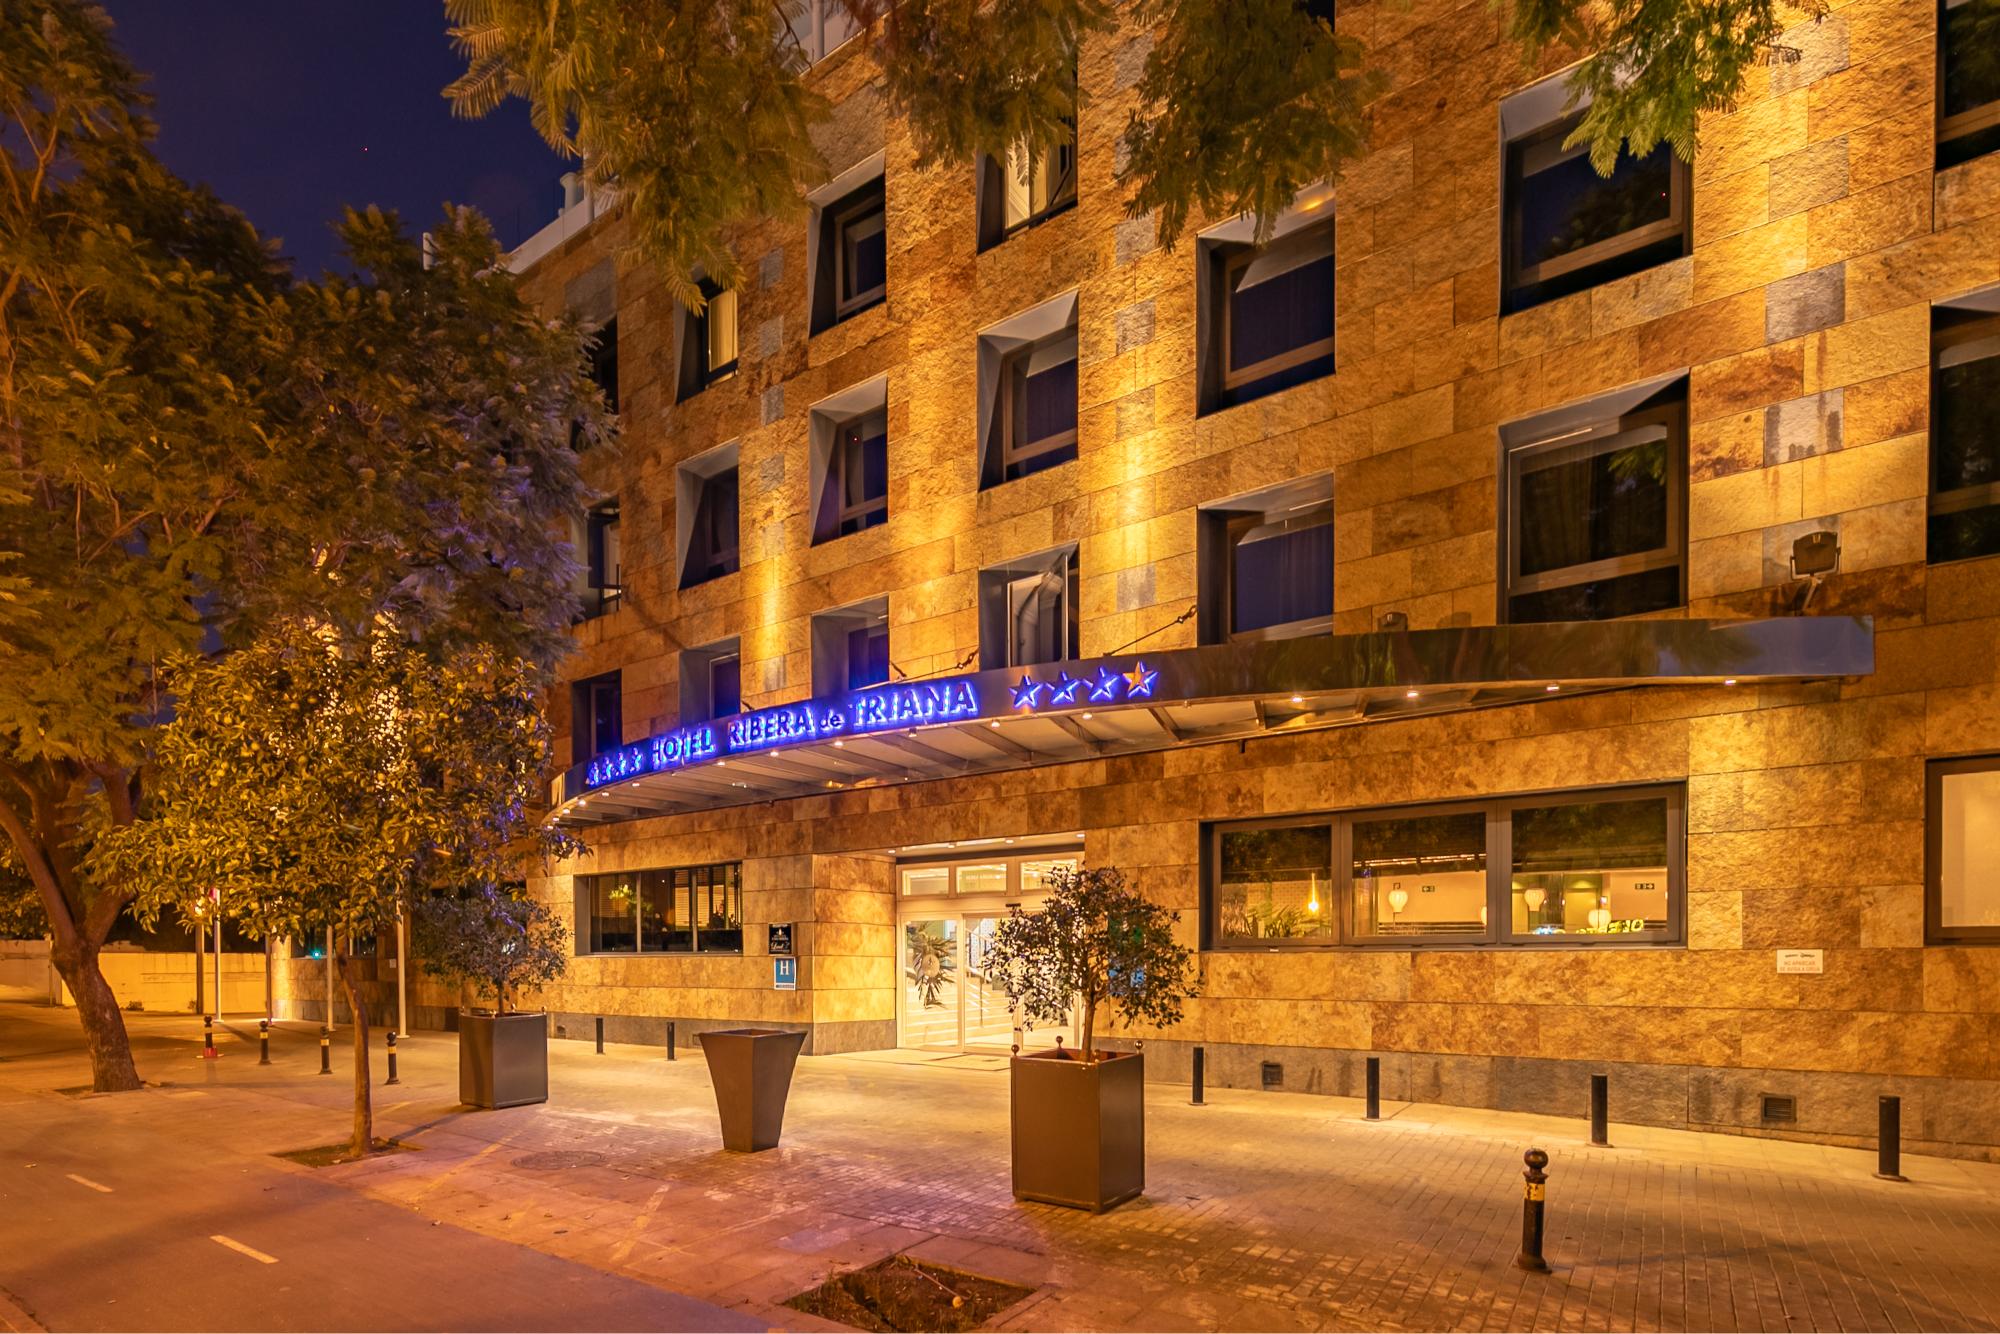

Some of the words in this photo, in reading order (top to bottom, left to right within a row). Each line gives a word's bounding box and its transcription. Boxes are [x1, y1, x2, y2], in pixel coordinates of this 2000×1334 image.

[652, 728, 716, 767] HOTEL
[728, 706, 816, 748] RIBERA
[819, 708, 844, 731] de
[848, 681, 978, 726] TRIANA
[780, 960, 789, 975] H
